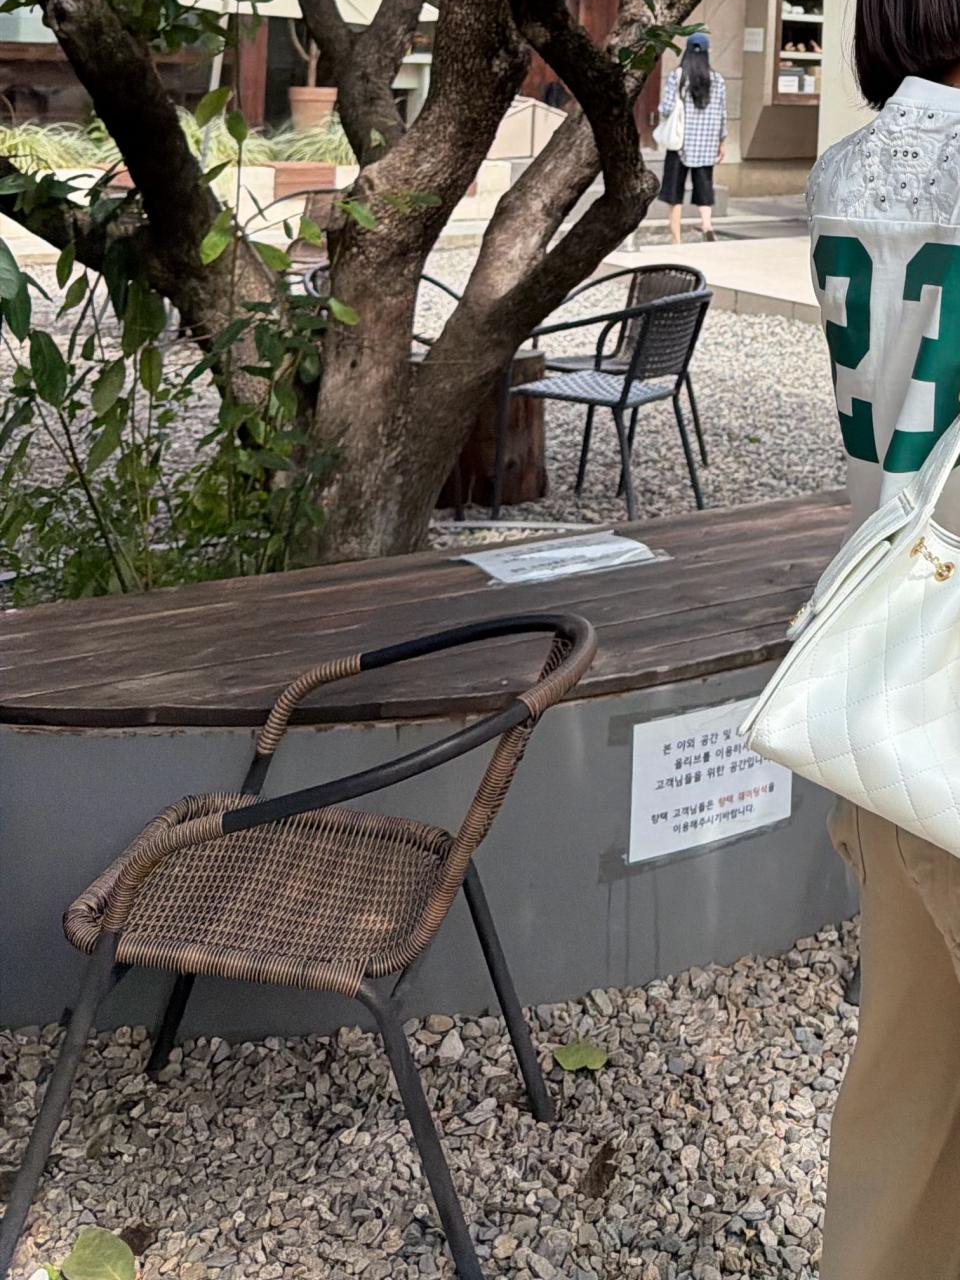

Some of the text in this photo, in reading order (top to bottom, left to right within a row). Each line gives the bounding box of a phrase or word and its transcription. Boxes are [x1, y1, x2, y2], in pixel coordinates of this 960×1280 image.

[663, 728, 731, 756] 본 야외 공간 및
[674, 751, 711, 770] 올리브를
[655, 756, 769, 790] 고객님들을 위한 공간입니
[672, 799, 714, 818] 고객님들은
